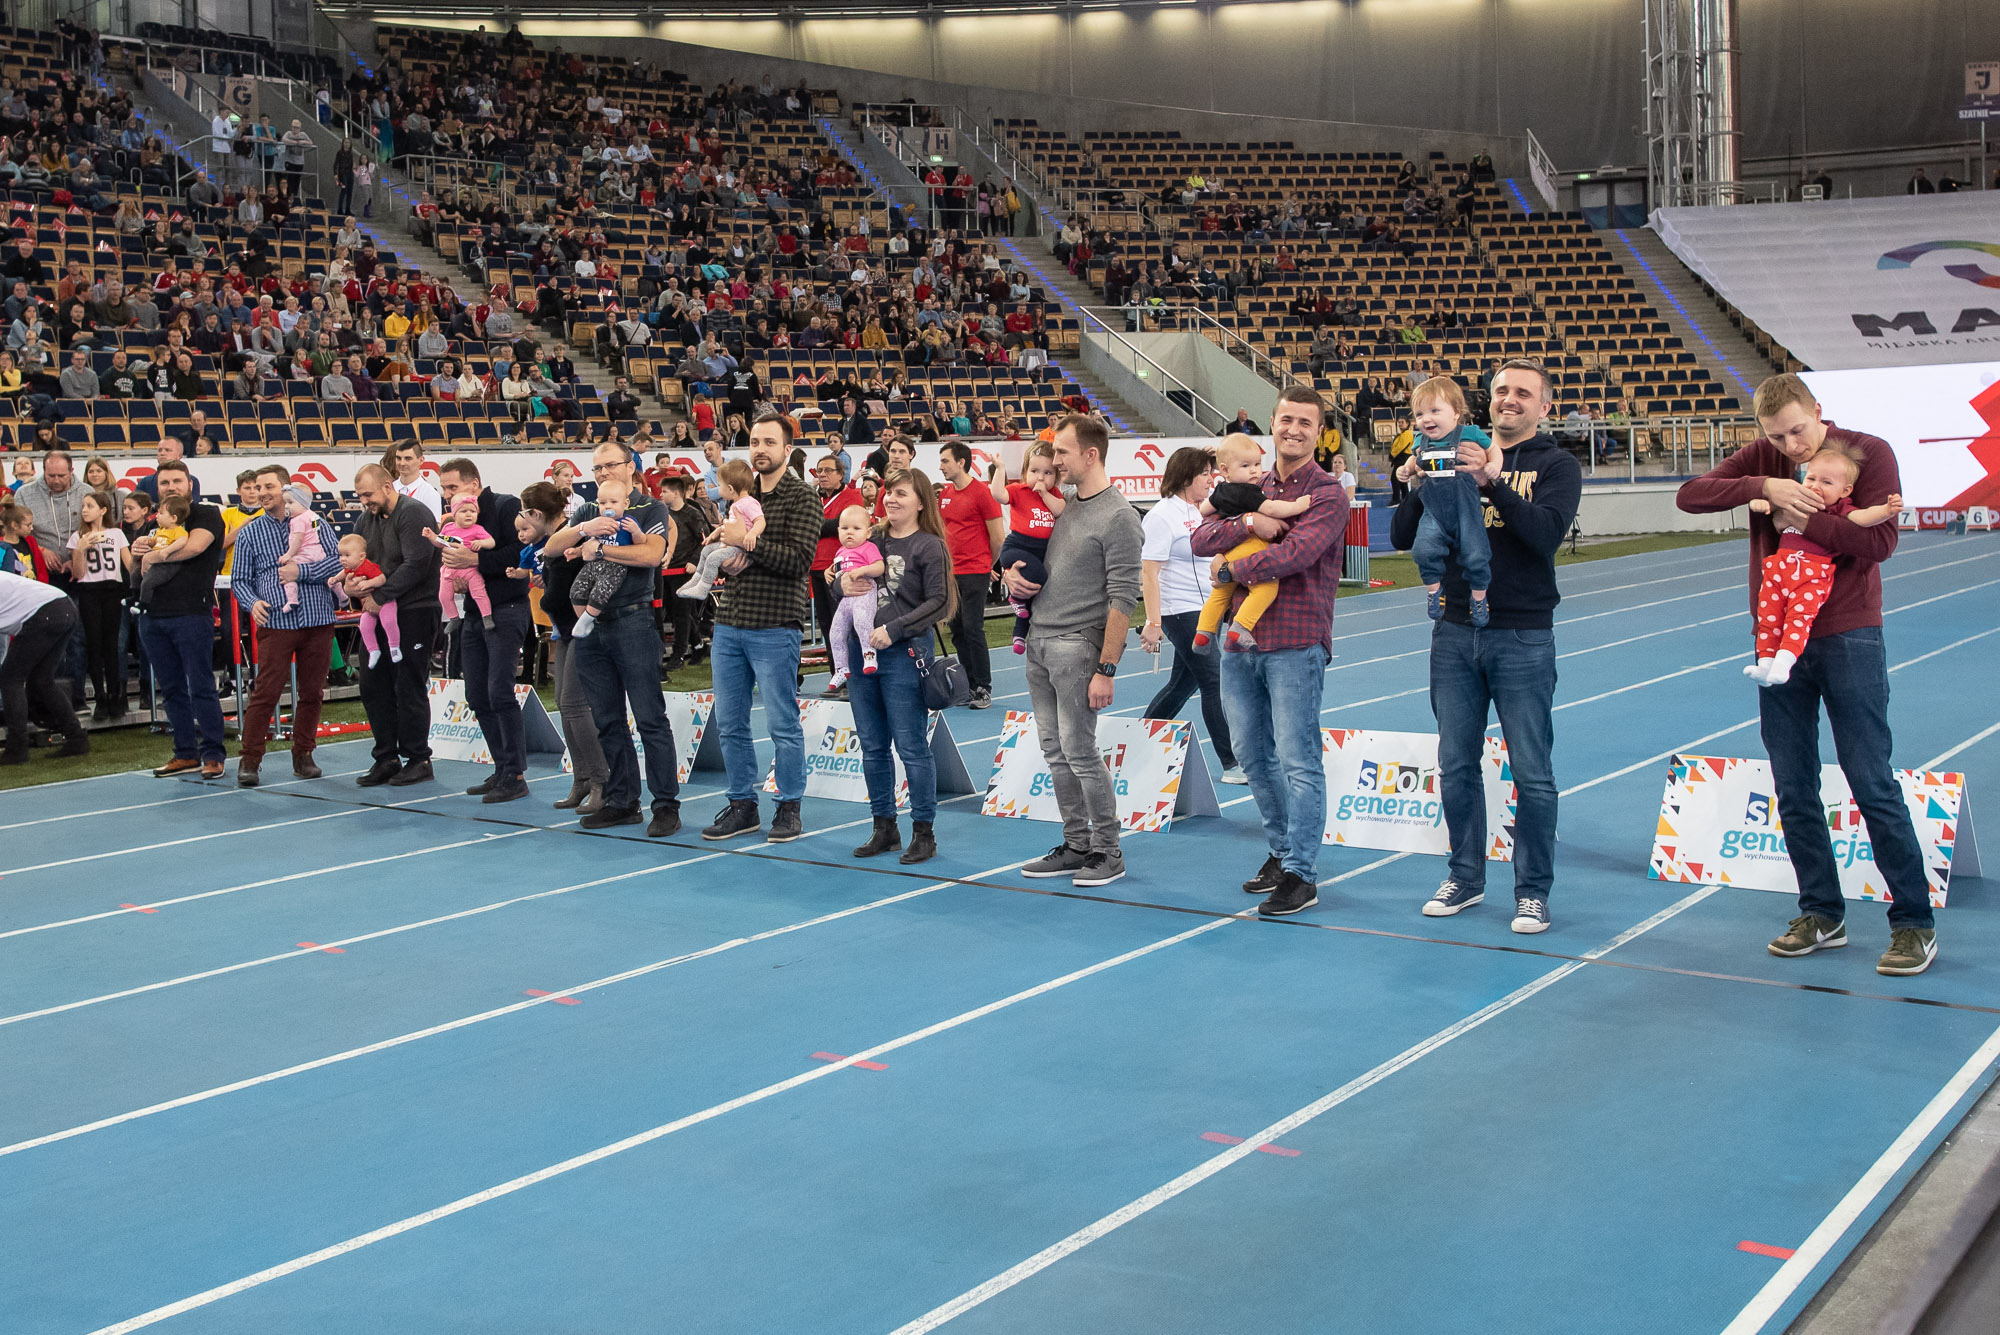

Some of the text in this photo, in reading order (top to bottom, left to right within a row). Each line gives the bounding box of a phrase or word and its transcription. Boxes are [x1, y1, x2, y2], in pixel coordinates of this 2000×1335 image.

[1974, 71, 1991, 90] J
[232, 85, 252, 106] G
[1959, 109, 1989, 119] SZATNIE
[935, 133, 949, 150] H
[1902, 512, 1911, 525] 7
[1973, 511, 1983, 524] 6
[86, 547, 116, 574] 95
[428, 723, 484, 745] generacja
[822, 725, 861, 754] spo
[806, 753, 865, 776] genera
[1336, 794, 1445, 829] generacj
[1356, 814, 1393, 823] wychowanie
